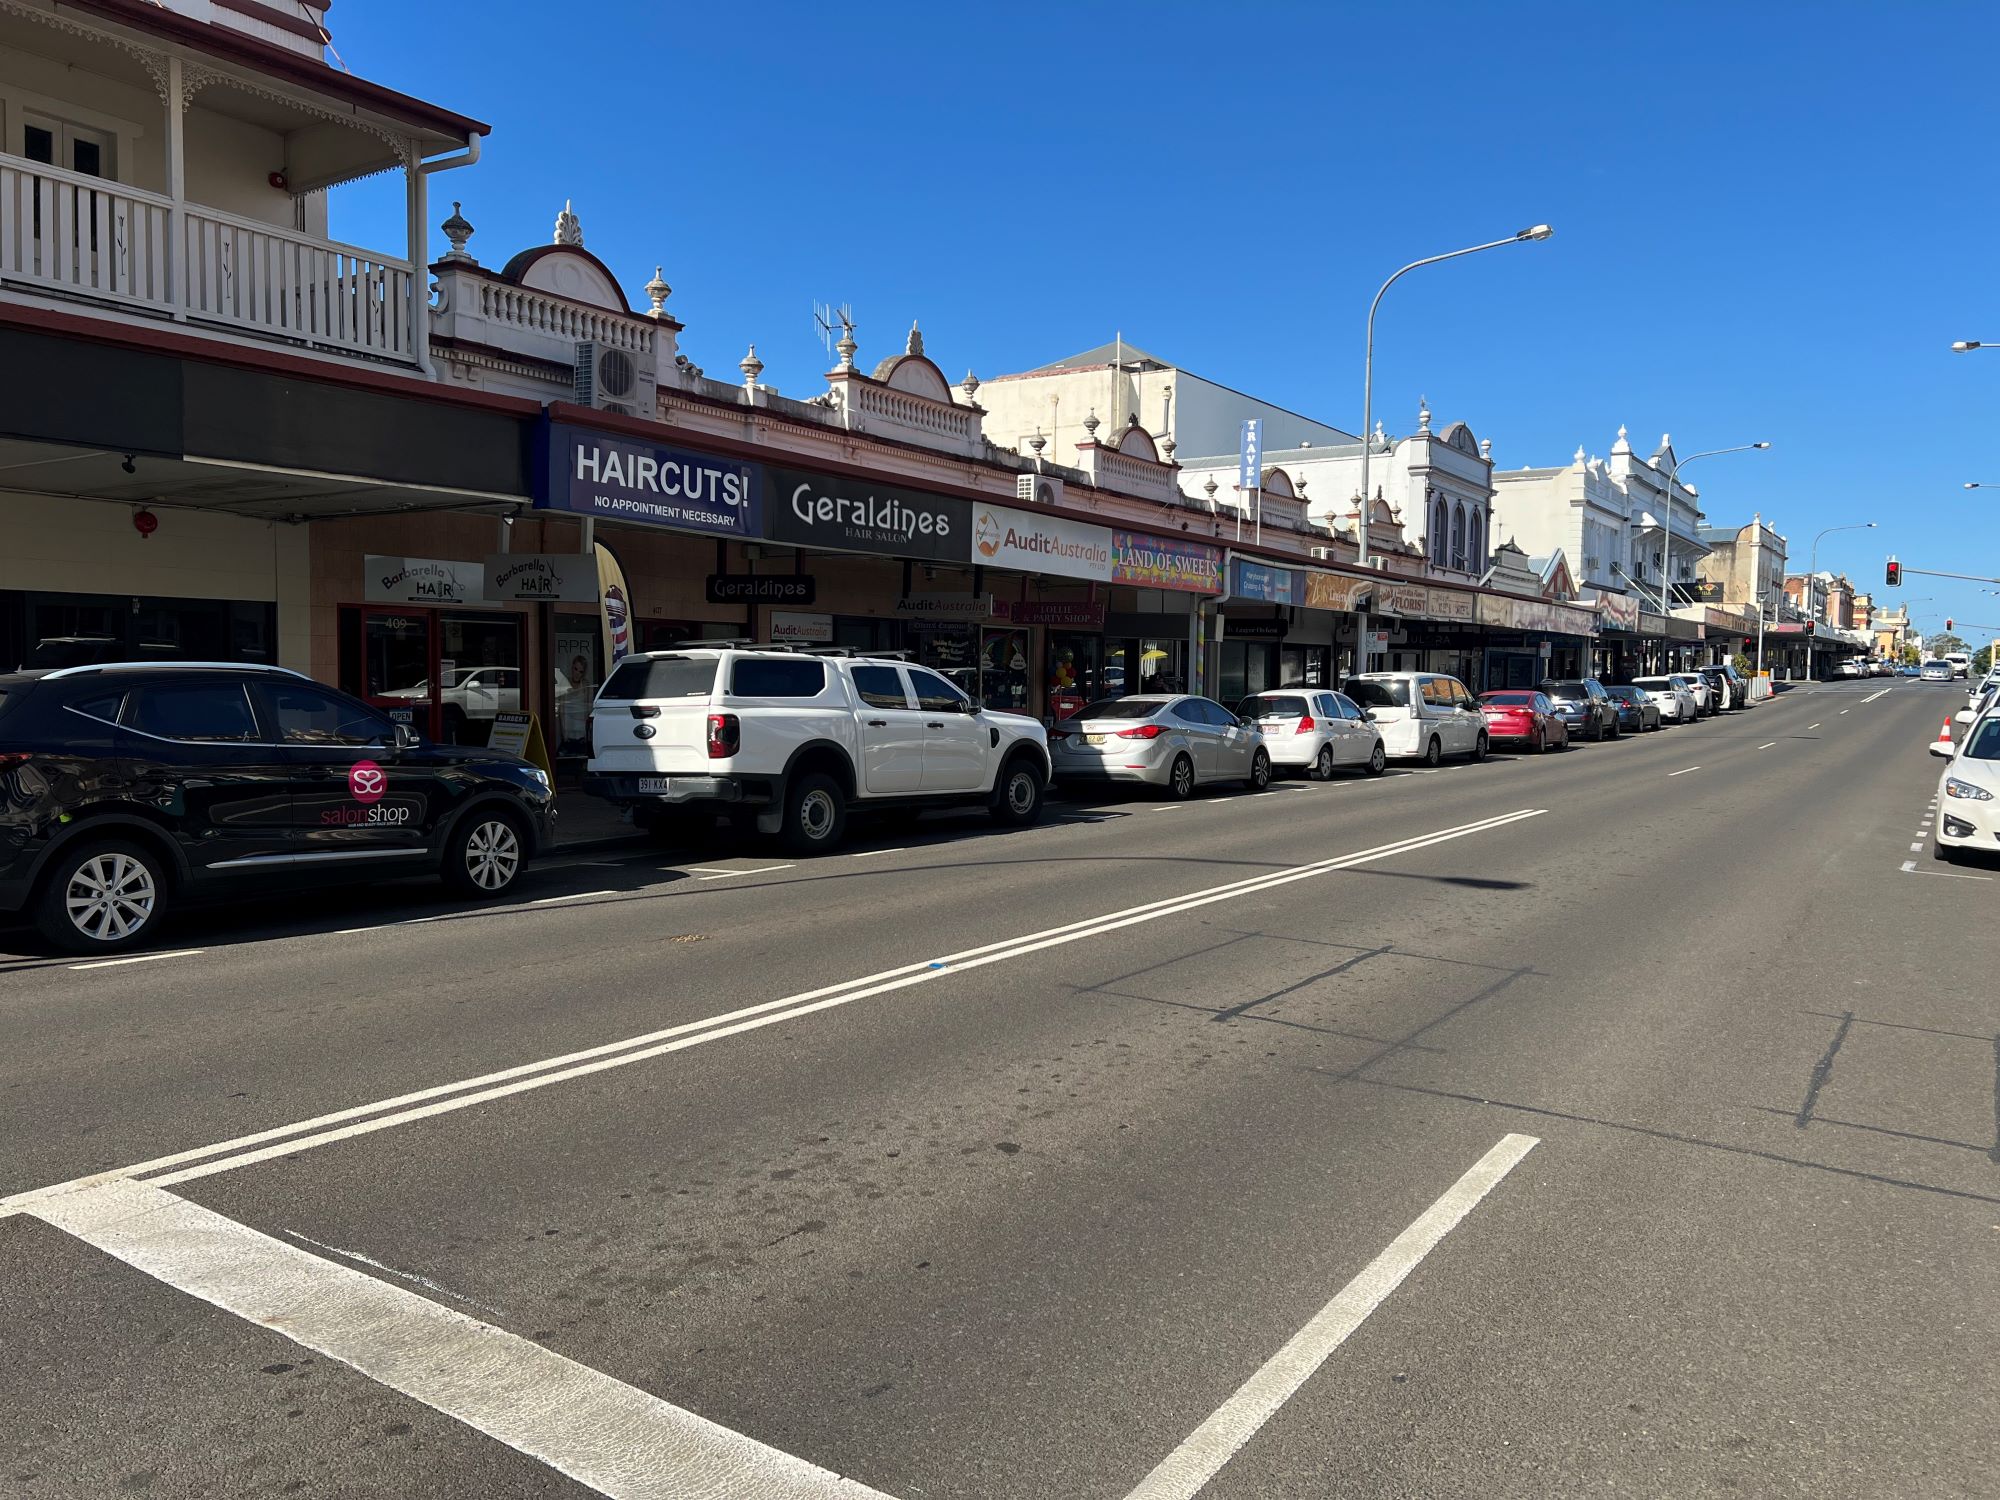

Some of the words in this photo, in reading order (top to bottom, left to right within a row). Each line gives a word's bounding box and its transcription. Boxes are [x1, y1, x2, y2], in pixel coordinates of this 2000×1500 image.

[1246, 420, 1257, 488] TRAVEL
[577, 444, 749, 508] HAIRCUTS!
[594, 495, 610, 508] NO
[612, 498, 680, 518] APPOINTMENT
[682, 509, 736, 527] NECESSARY
[792, 483, 950, 540] Geraldines
[845, 527, 873, 540] HAIR
[876, 531, 907, 544] SALON
[1119, 547, 1153, 569] LAND
[1157, 552, 1172, 572] OF
[1175, 555, 1217, 577] SWEETS
[382, 563, 445, 590] Barbarella
[496, 558, 546, 587] Barbarella
[714, 579, 807, 598] Geraldines
[1395, 597, 1426, 612] FLORIST
[385, 618, 407, 629] 409
[1033, 614, 1063, 623] PARTY
[1064, 614, 1090, 623] SHOP
[557, 639, 590, 653] RPR
[391, 712, 411, 721] OPEN
[498, 714, 523, 722] BARBER
[641, 779, 651, 789] 391
